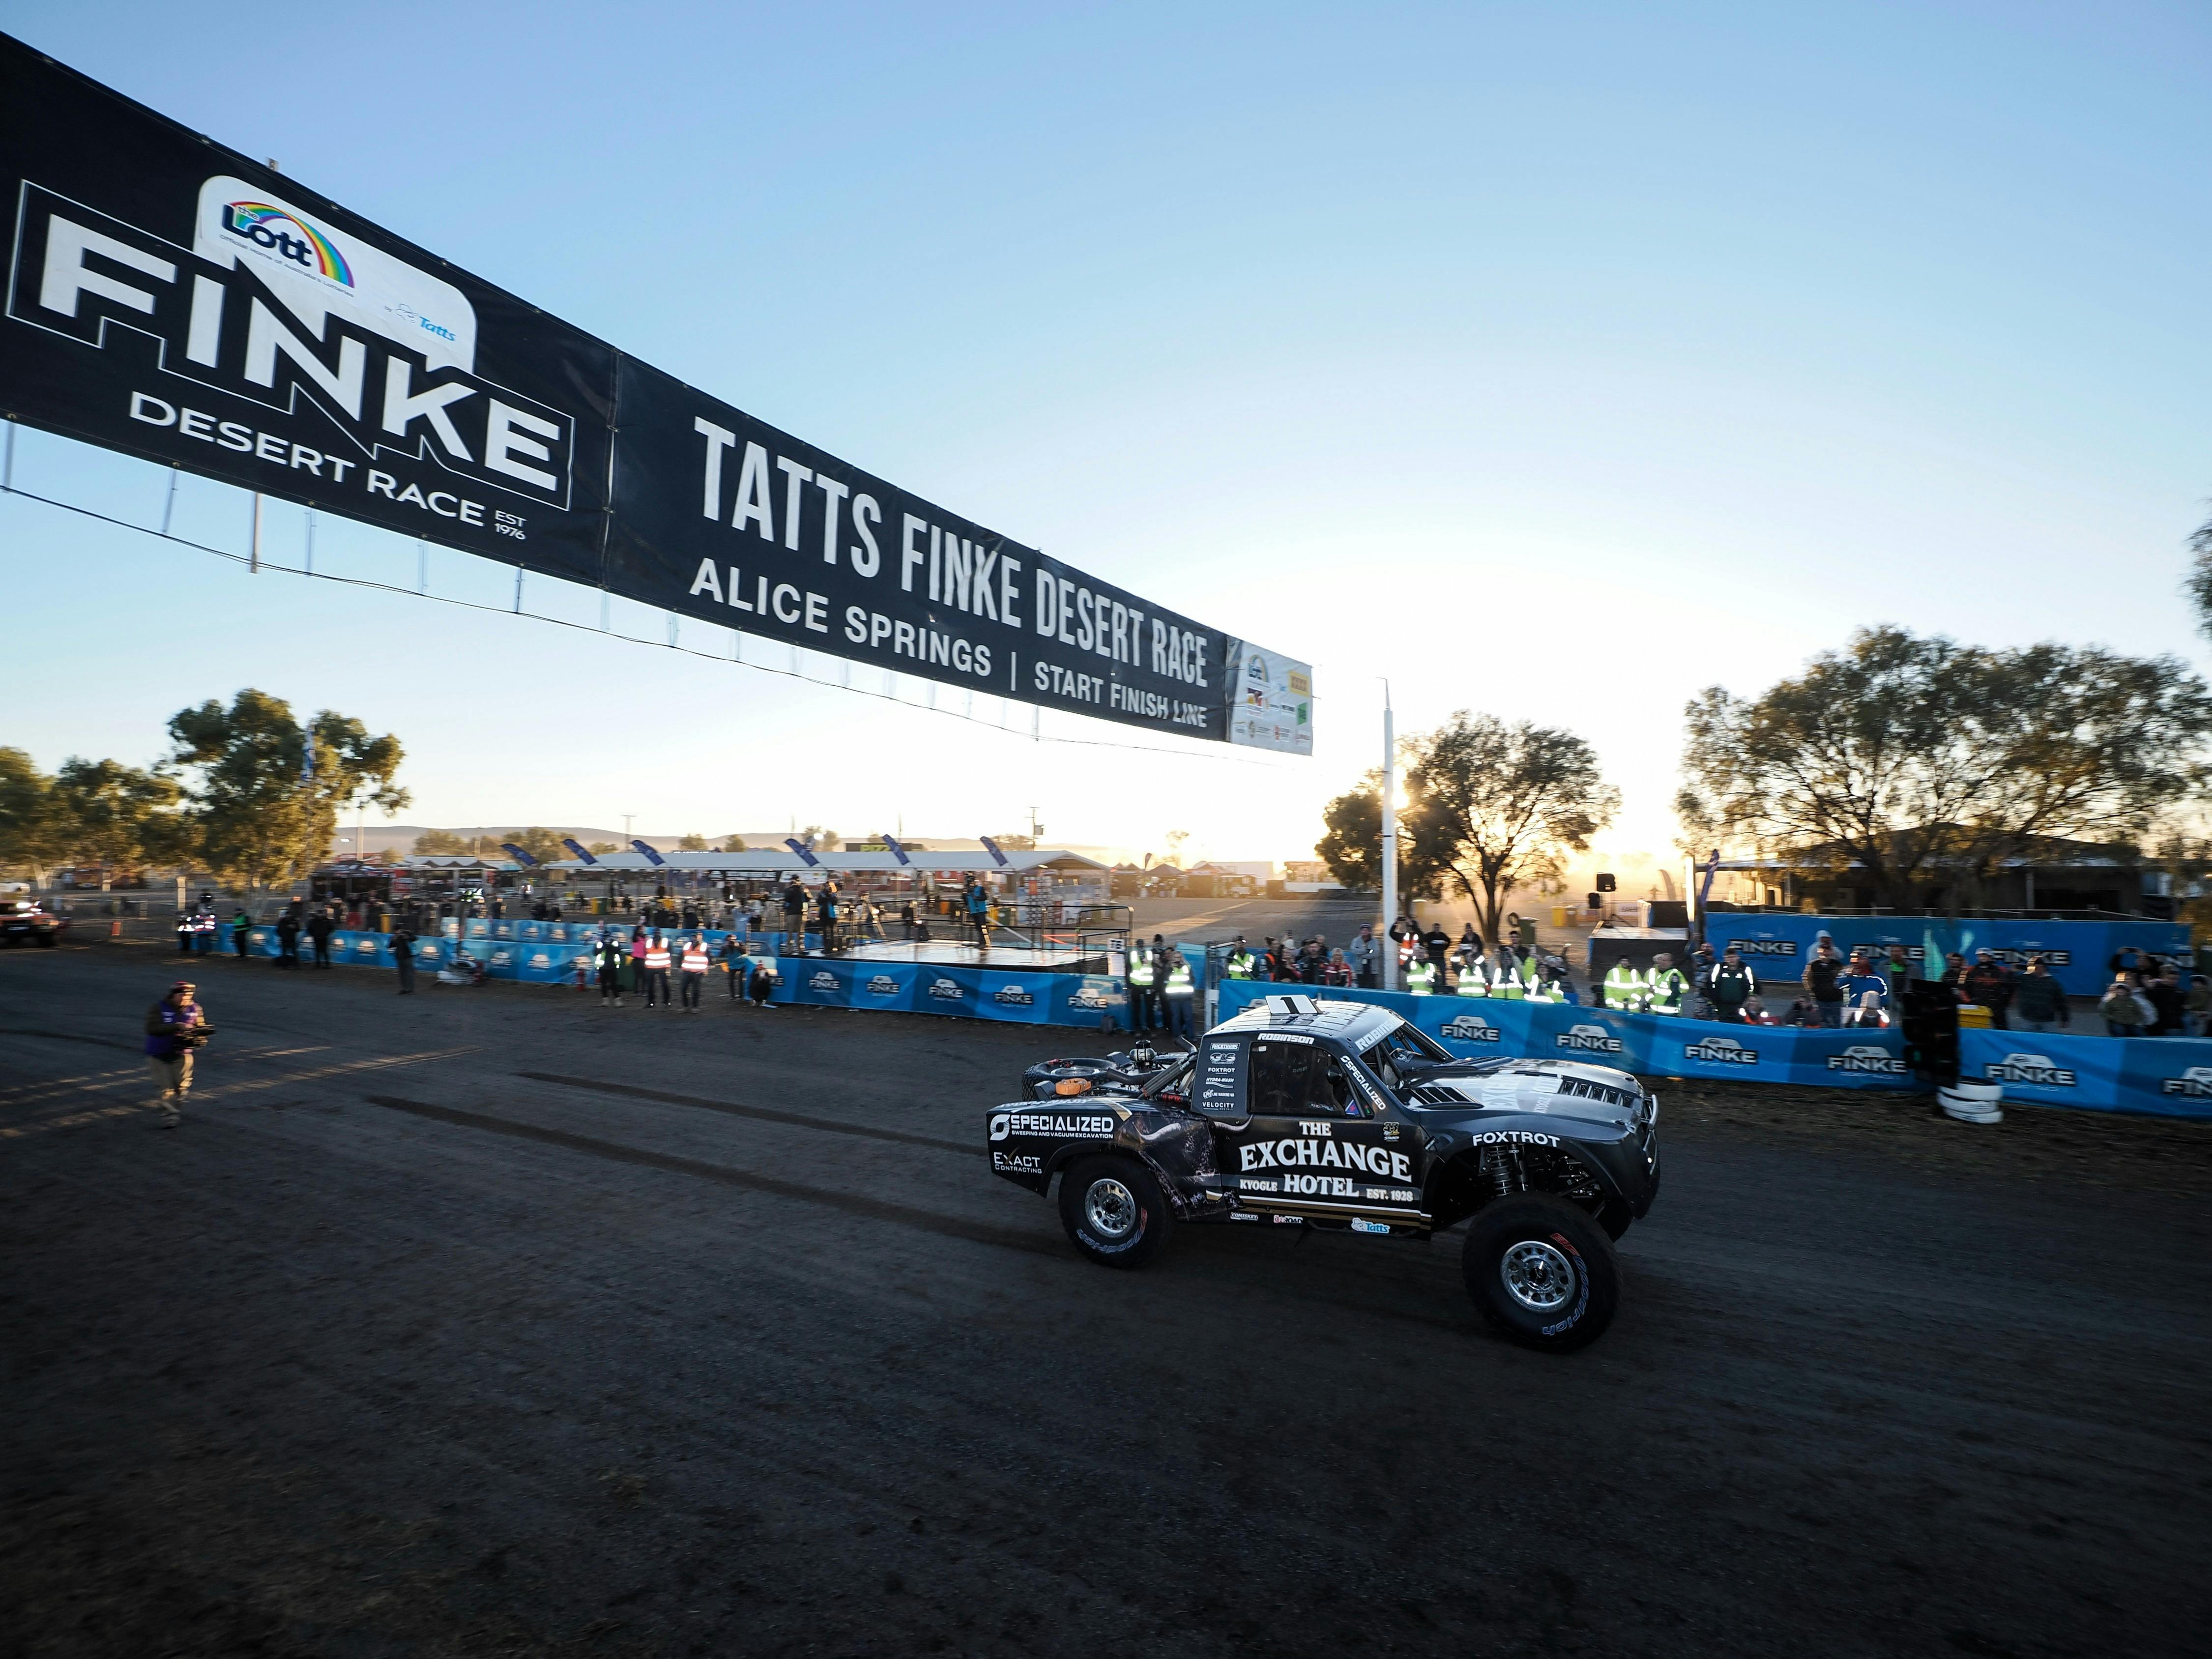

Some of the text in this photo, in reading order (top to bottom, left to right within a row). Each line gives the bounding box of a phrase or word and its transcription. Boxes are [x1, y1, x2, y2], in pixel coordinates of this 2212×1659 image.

[237, 206, 260, 220] the
[222, 204, 312, 267] Lott
[419, 316, 456, 342] Tatts
[39, 213, 559, 492] FINKE
[129, 390, 486, 527] DESERT RACE
[494, 509, 527, 528] EST
[494, 523, 527, 541] 1976
[694, 416, 1208, 688] TATTS FINKE DESERT RACE
[689, 558, 1208, 728] ALICE SPRINGS START FINISH LINE
[1729, 940, 1796, 955] FINKE
[929, 986, 963, 998] FINKE
[995, 992, 1033, 1004] FINKE
[1068, 996, 1107, 1008] FINKE
[1280, 997, 1300, 1014] 1
[1257, 1033, 1315, 1045] ROBINSON
[1441, 1025, 1499, 1041] FINKE
[1556, 1035, 1622, 1051] FINKE
[1210, 1052, 1236, 1062] G&S
[1685, 1046, 1757, 1063] FINKE
[1828, 1057, 1908, 1073] FINKE
[1985, 1065, 2076, 1084] FINKE
[1345, 1060, 1386, 1110] SPECIALIZED
[1011, 1114, 1114, 1133] SPECIALIZED
[1299, 1121, 1332, 1136] THE
[1472, 1131, 1561, 1148] FOXTROT
[993, 1151, 1040, 1168] EXACT
[1239, 1139, 1413, 1183] EXCHANGE
[995, 1164, 1042, 1174] CONTRACTING
[1239, 1173, 1414, 1202] KYOGLE HOTEL EST. 1928
[1366, 1222, 1389, 1233] Tatts
